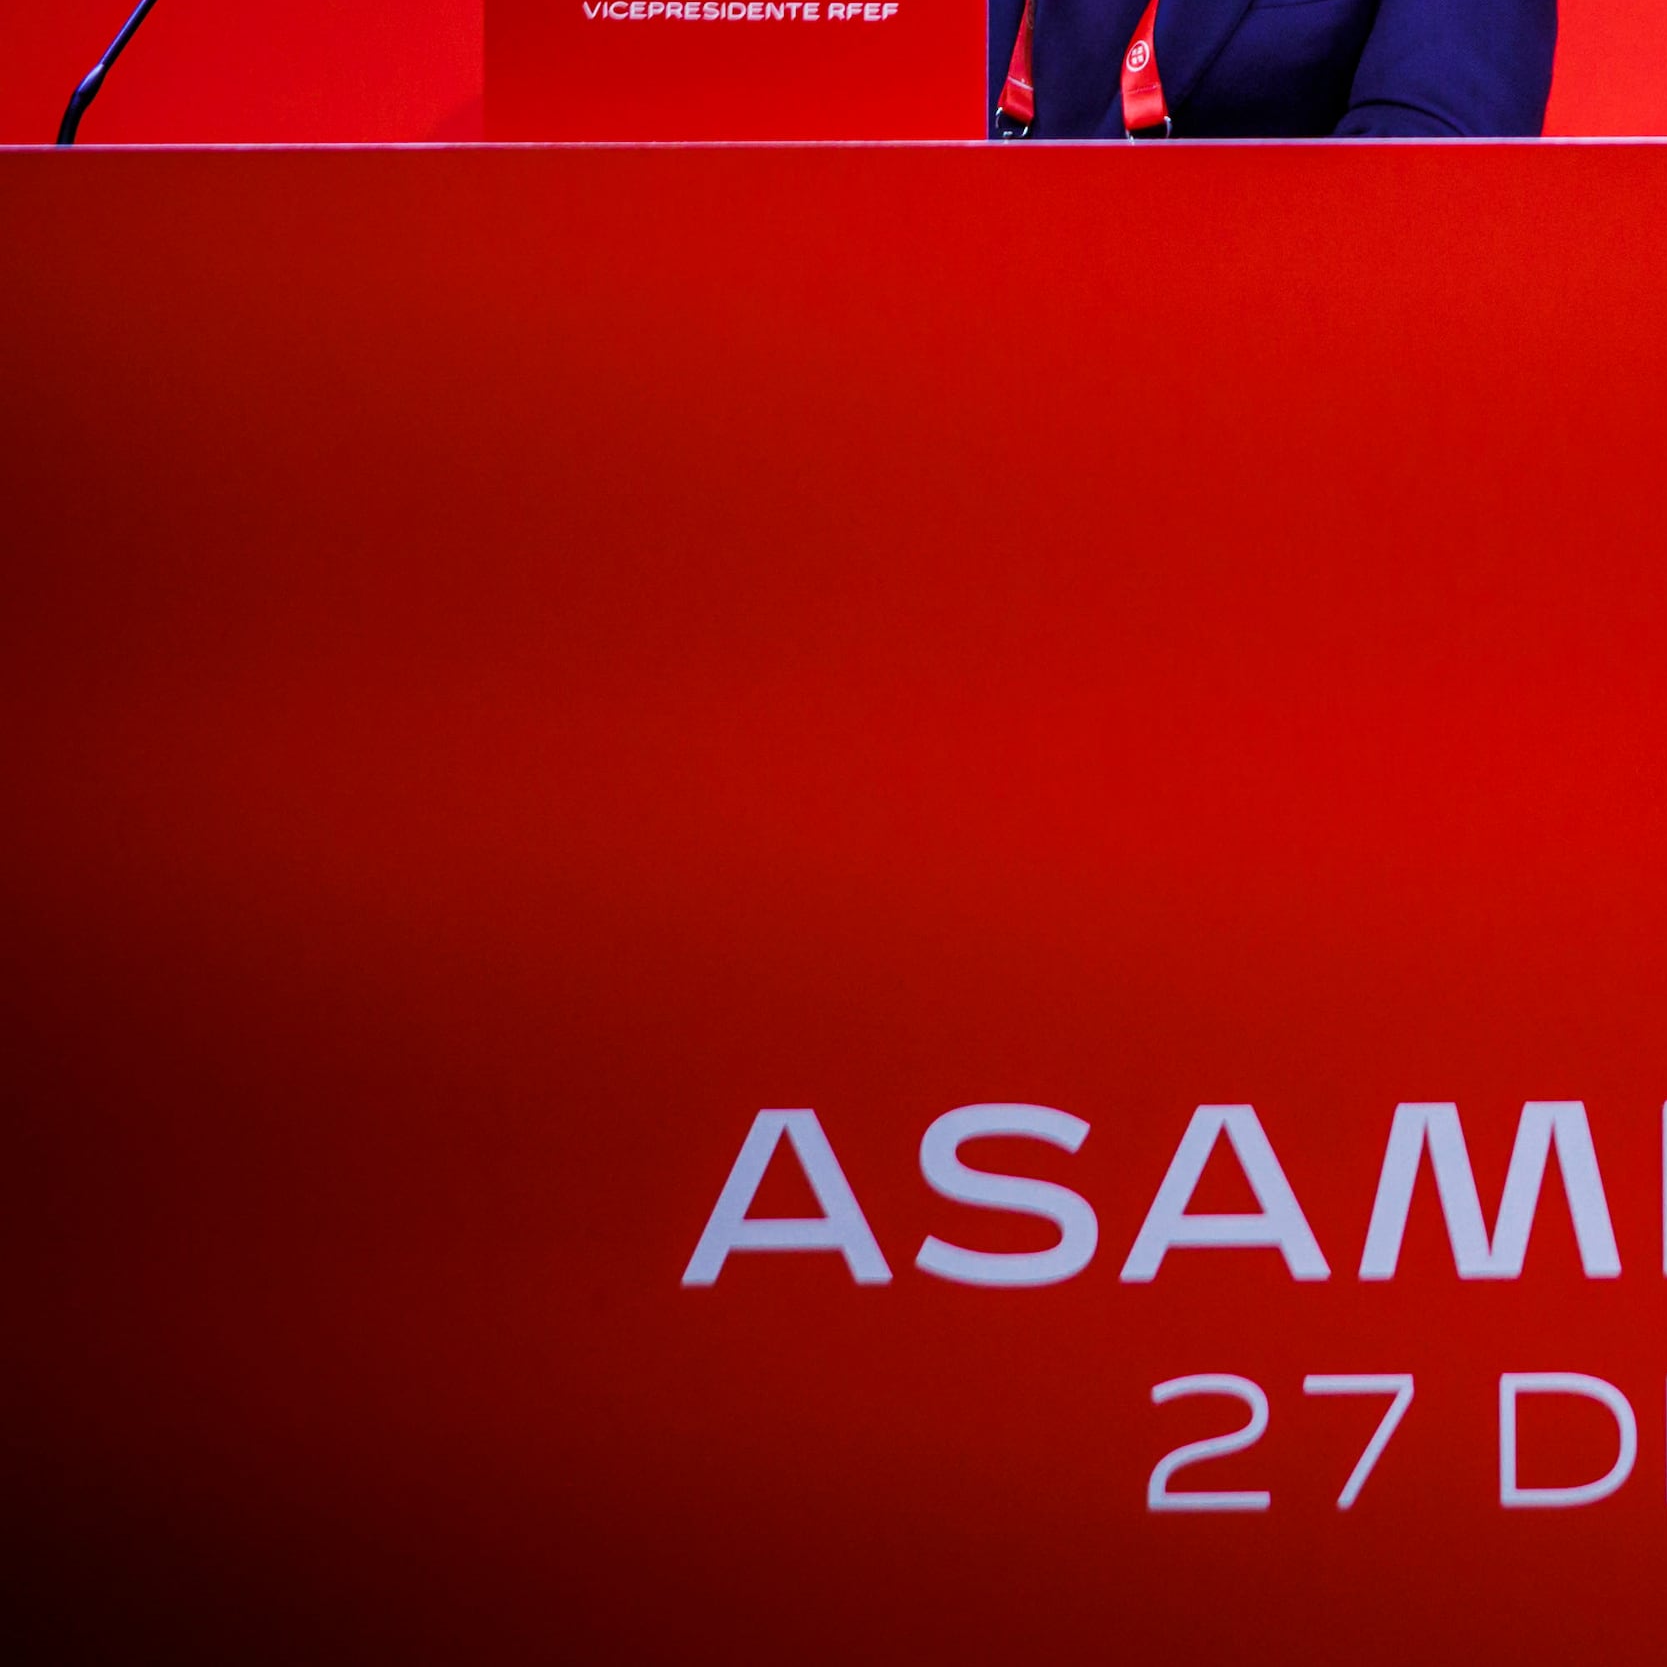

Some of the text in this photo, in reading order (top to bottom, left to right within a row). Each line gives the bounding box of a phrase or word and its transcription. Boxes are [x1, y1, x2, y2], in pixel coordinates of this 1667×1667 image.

[583, 0, 899, 21] VICEPRESIDENTE RFEF
[1146, 1372, 1415, 1512] 27
